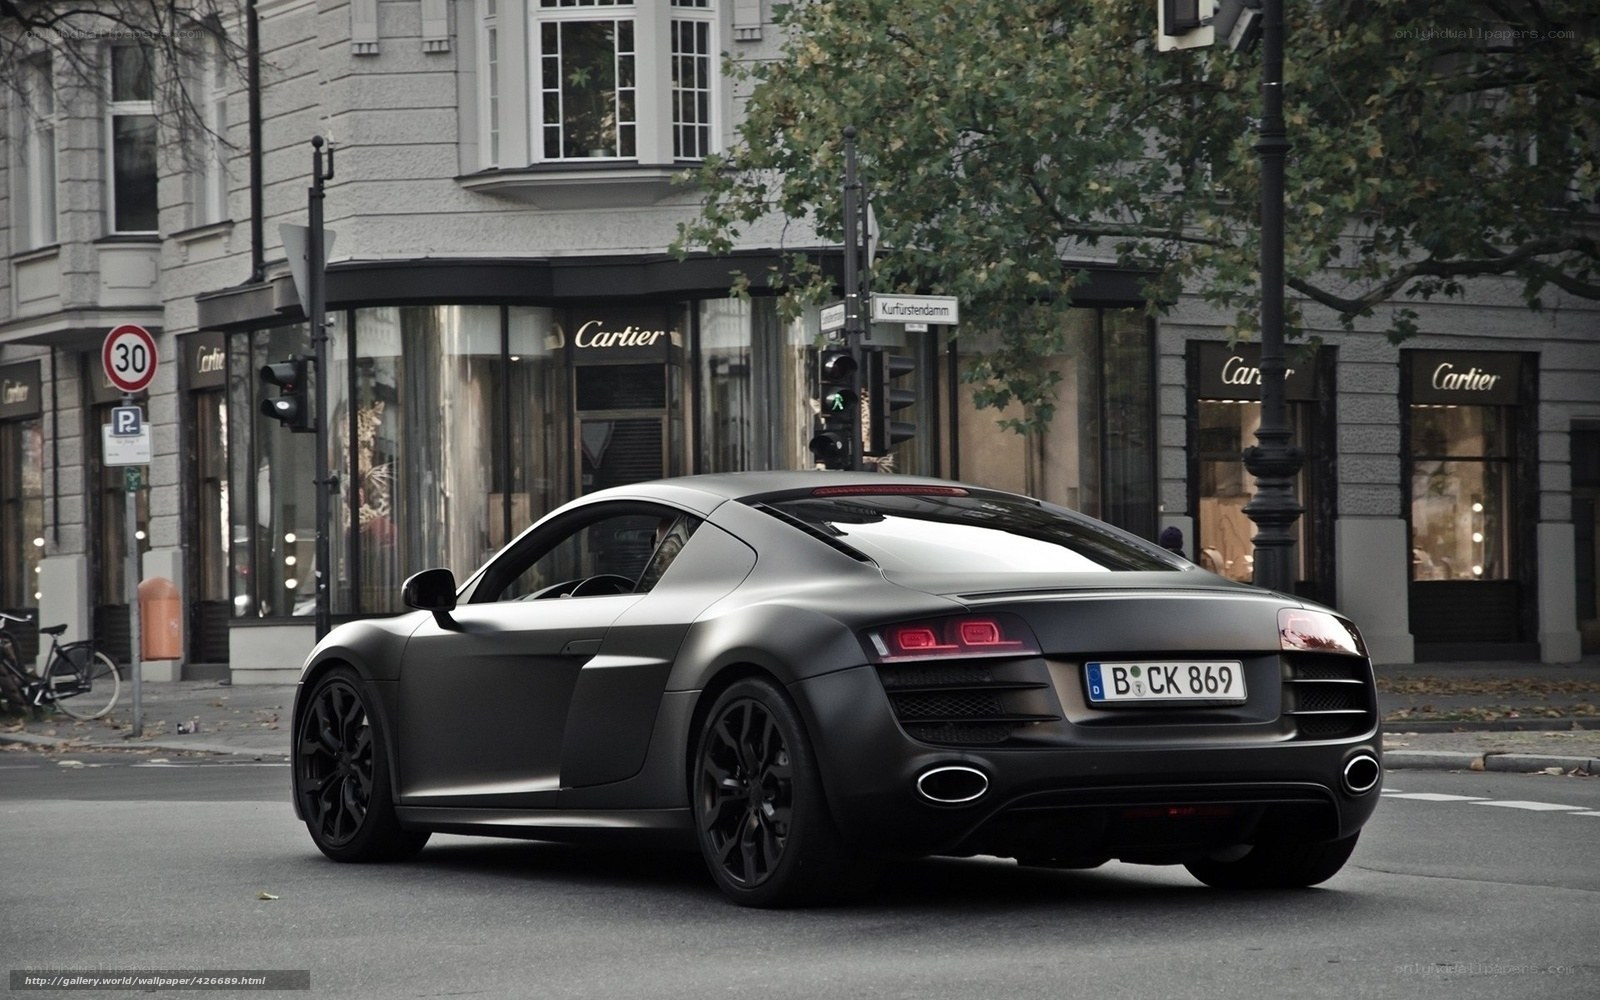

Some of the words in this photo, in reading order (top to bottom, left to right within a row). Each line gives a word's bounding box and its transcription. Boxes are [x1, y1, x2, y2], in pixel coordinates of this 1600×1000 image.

[881, 302, 949, 316] Kurfürstendamm
[574, 320, 665, 348] Cartier
[115, 343, 146, 373] 30
[196, 345, 225, 373] Cartie
[1432, 362, 1501, 391] Cartier
[118, 410, 136, 433] P
[1112, 667, 1130, 695] B
[1147, 666, 1182, 695] CK
[1187, 665, 1233, 694] 869
